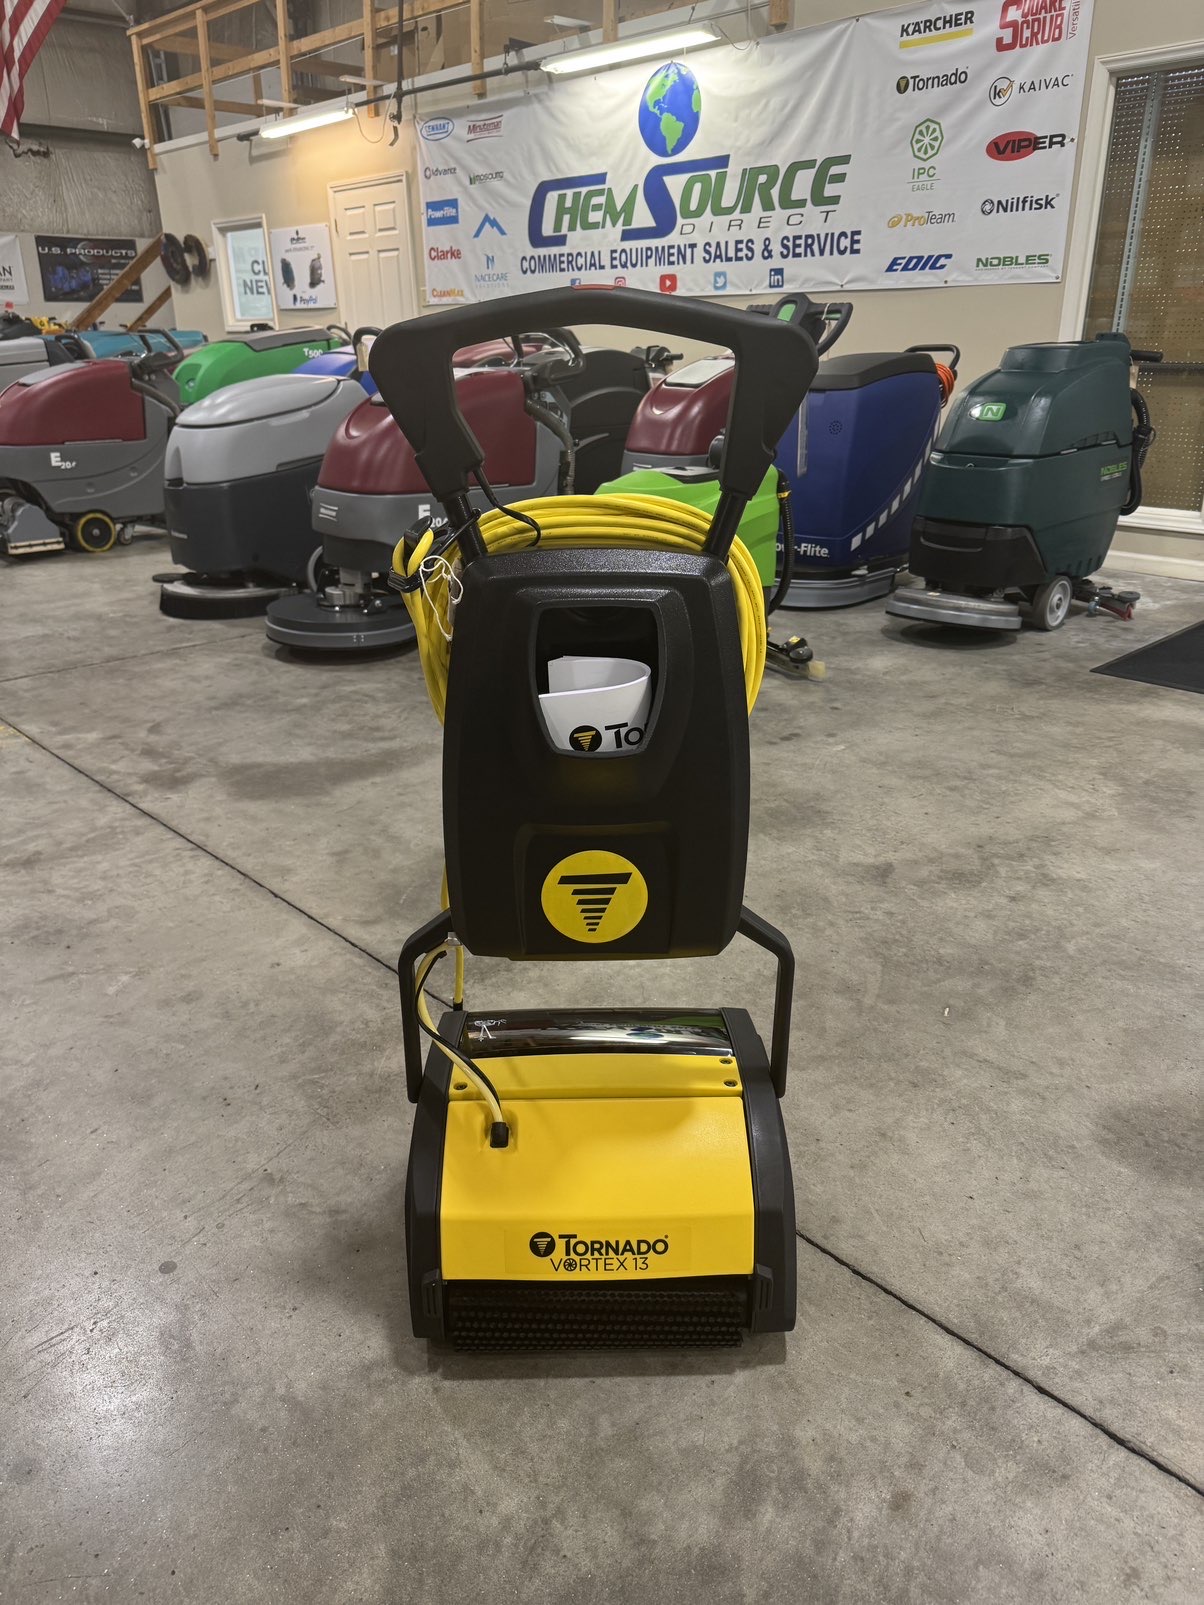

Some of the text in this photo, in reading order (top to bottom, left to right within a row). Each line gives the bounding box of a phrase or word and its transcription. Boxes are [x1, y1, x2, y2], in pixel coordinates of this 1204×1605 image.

[899, 10, 975, 38] KÄRCHER
[996, 10, 1064, 52] SCRUB
[910, 67, 968, 93] Tornado
[1018, 74, 1070, 94] KAIVAC
[993, 132, 1066, 156] VIPER
[912, 166, 937, 180] IPC
[912, 183, 935, 192] EAGLE
[996, 194, 1056, 214] Nilfisk
[679, 209, 837, 236] DIRECT
[903, 210, 956, 228] ProTeam
[38, 246, 136, 257] U.S. PRODUCTS
[429, 245, 462, 261] Clarke
[520, 230, 862, 275] COMMERCIAL EQUIPMENT SALES & SERVICE
[975, 253, 1050, 268] NOBLES
[885, 254, 953, 272] EDIC
[558, 1233, 669, 1257] TORNADO
[550, 1256, 649, 1272] VORTEX 13
